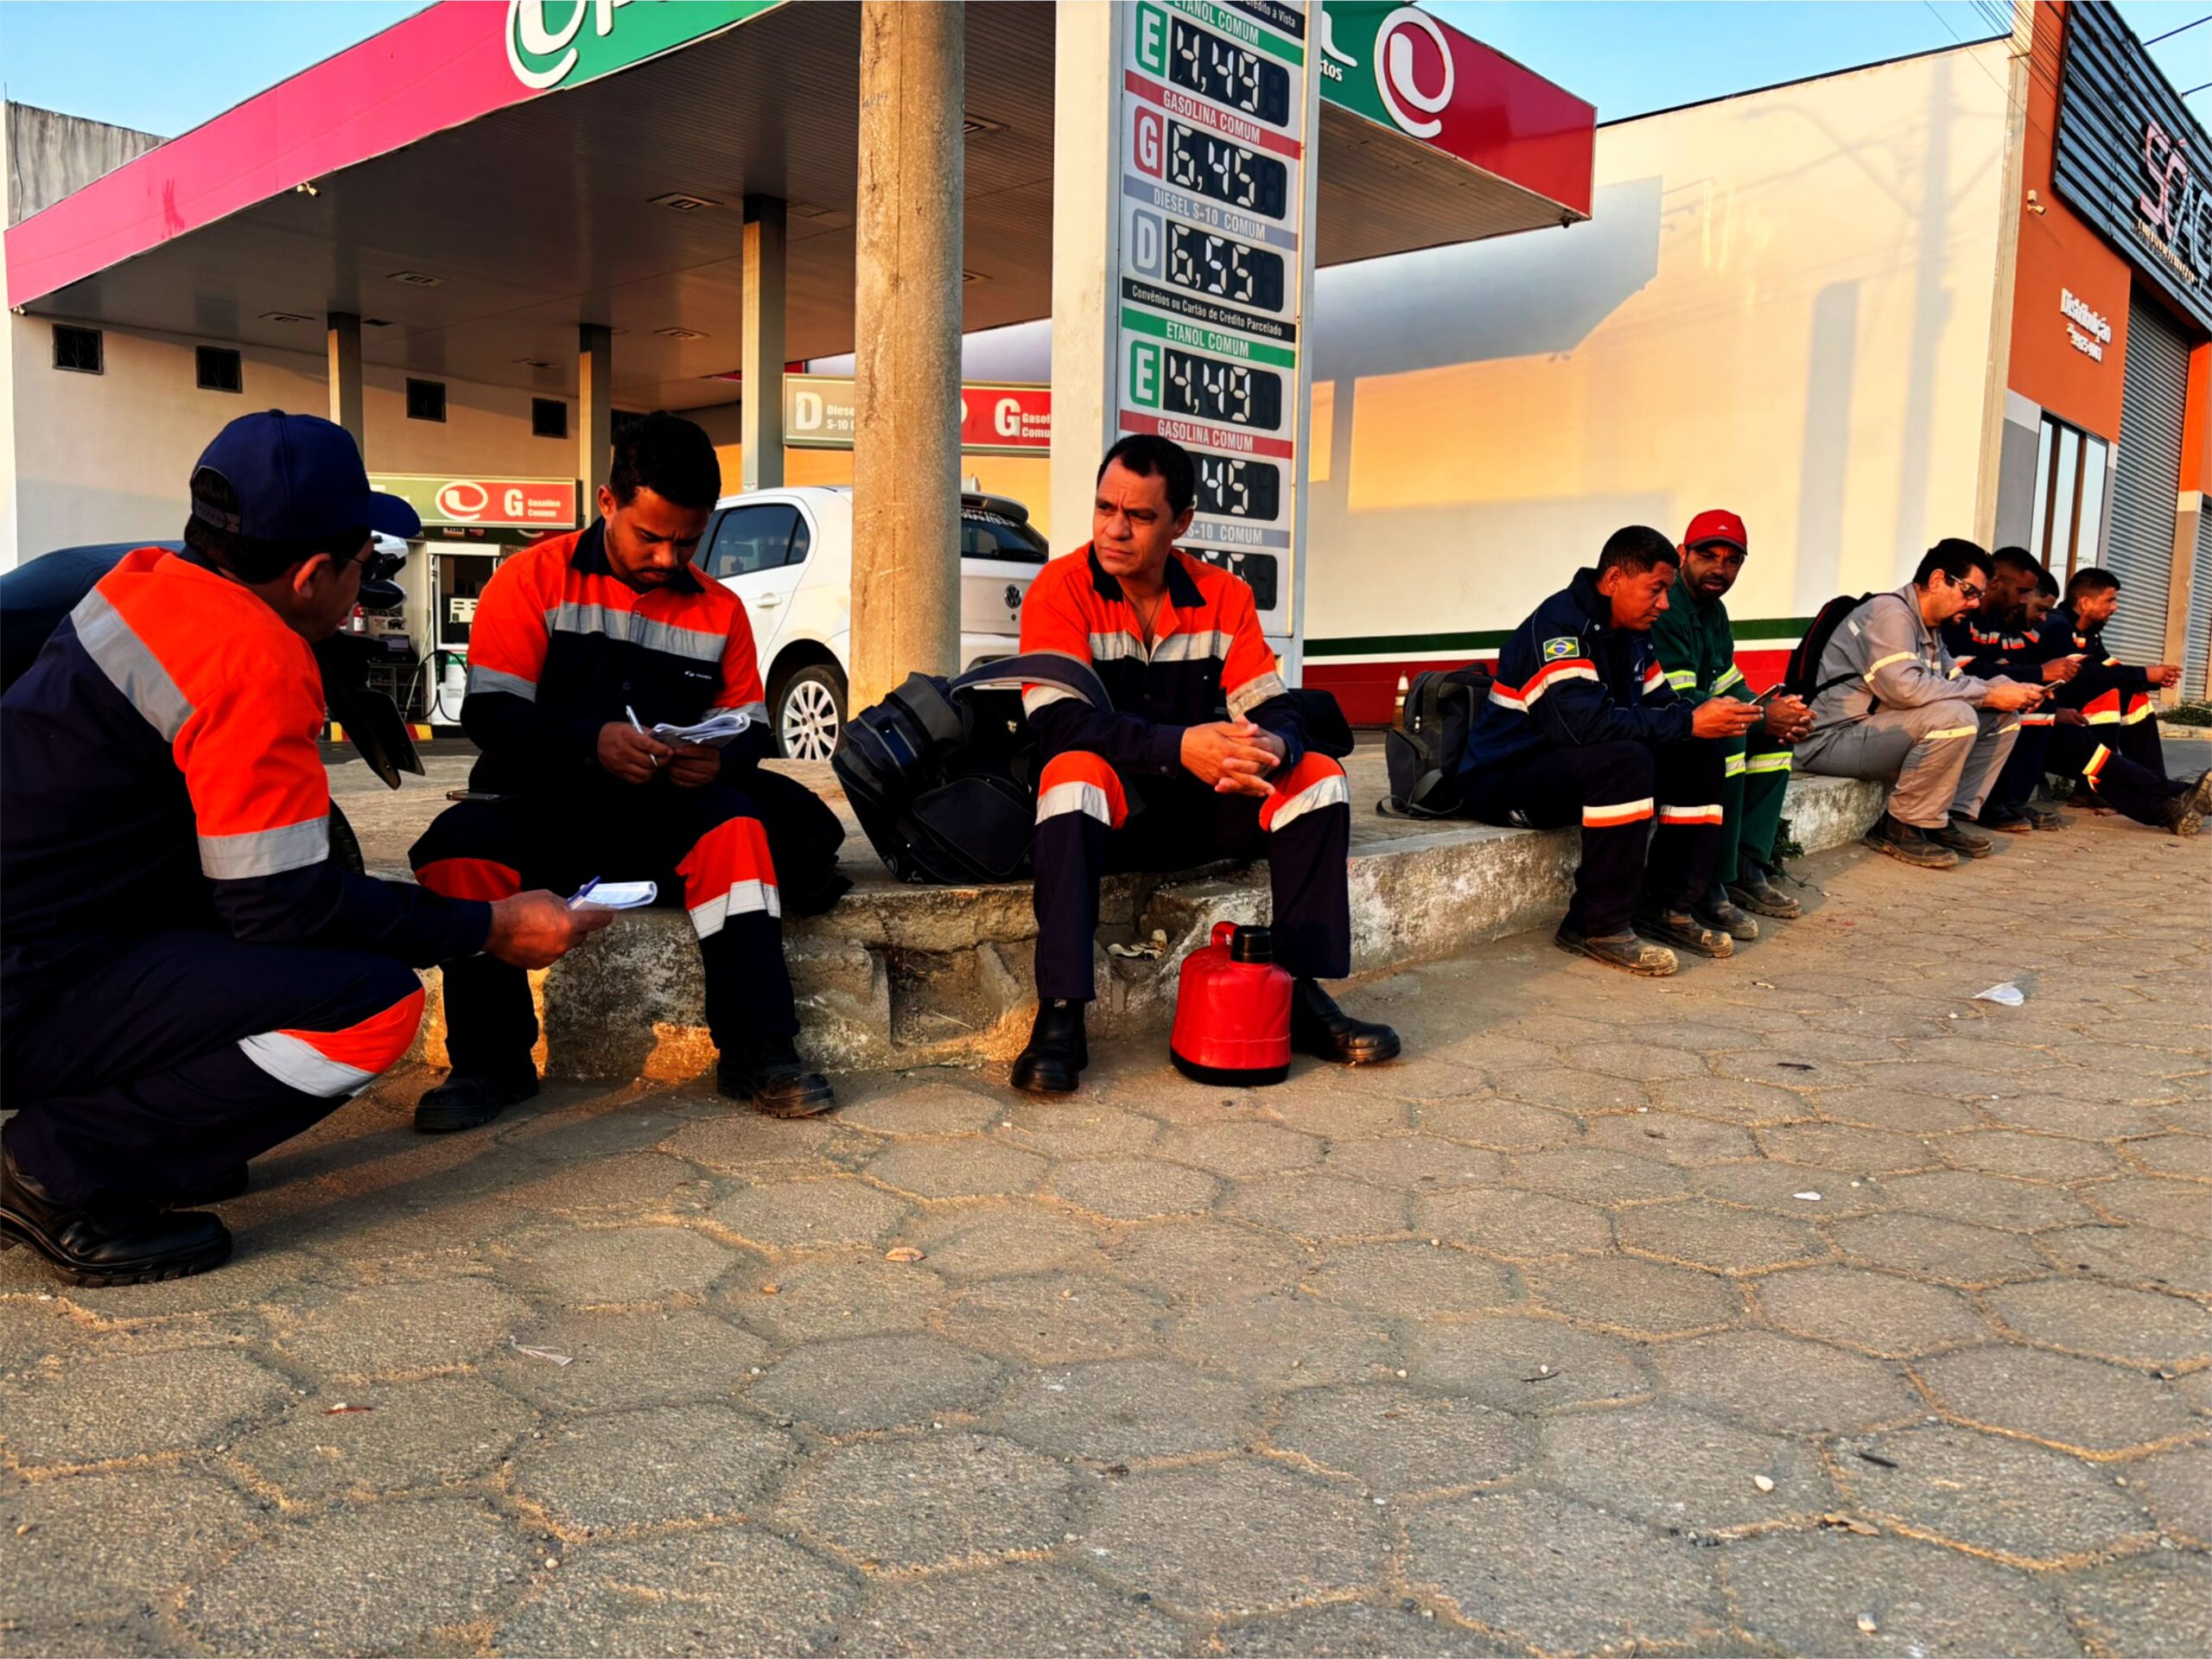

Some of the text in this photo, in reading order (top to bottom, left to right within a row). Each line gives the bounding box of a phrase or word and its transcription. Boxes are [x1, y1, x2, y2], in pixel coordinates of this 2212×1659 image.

[1141, 9, 1161, 68] E
[1218, 11, 1259, 45] COMUM
[1279, 10, 1296, 29] Vista
[1177, 25, 1260, 112] 4,49
[1140, 115, 1158, 170] G
[1164, 90, 1261, 144] GASOLINA COMUM
[1173, 124, 1255, 207] 6,45
[1154, 188, 1266, 241] DIESEL S-10 COMUM
[1137, 214, 1158, 270] D
[1172, 223, 1253, 302] 6,55
[1132, 284, 1283, 337] Convênios ou Cartão de Crédito Parcelado
[1166, 321, 1249, 358] ETANOL COMUM
[1136, 346, 1154, 400] E
[1169, 354, 1251, 423] 4,49
[795, 391, 823, 429] D
[827, 418, 849, 430] S-10
[995, 397, 1020, 437] G
[1157, 419, 1254, 452] GASOLINA COMUM
[505, 488, 524, 517] G
[1220, 524, 1262, 544] COMUM
